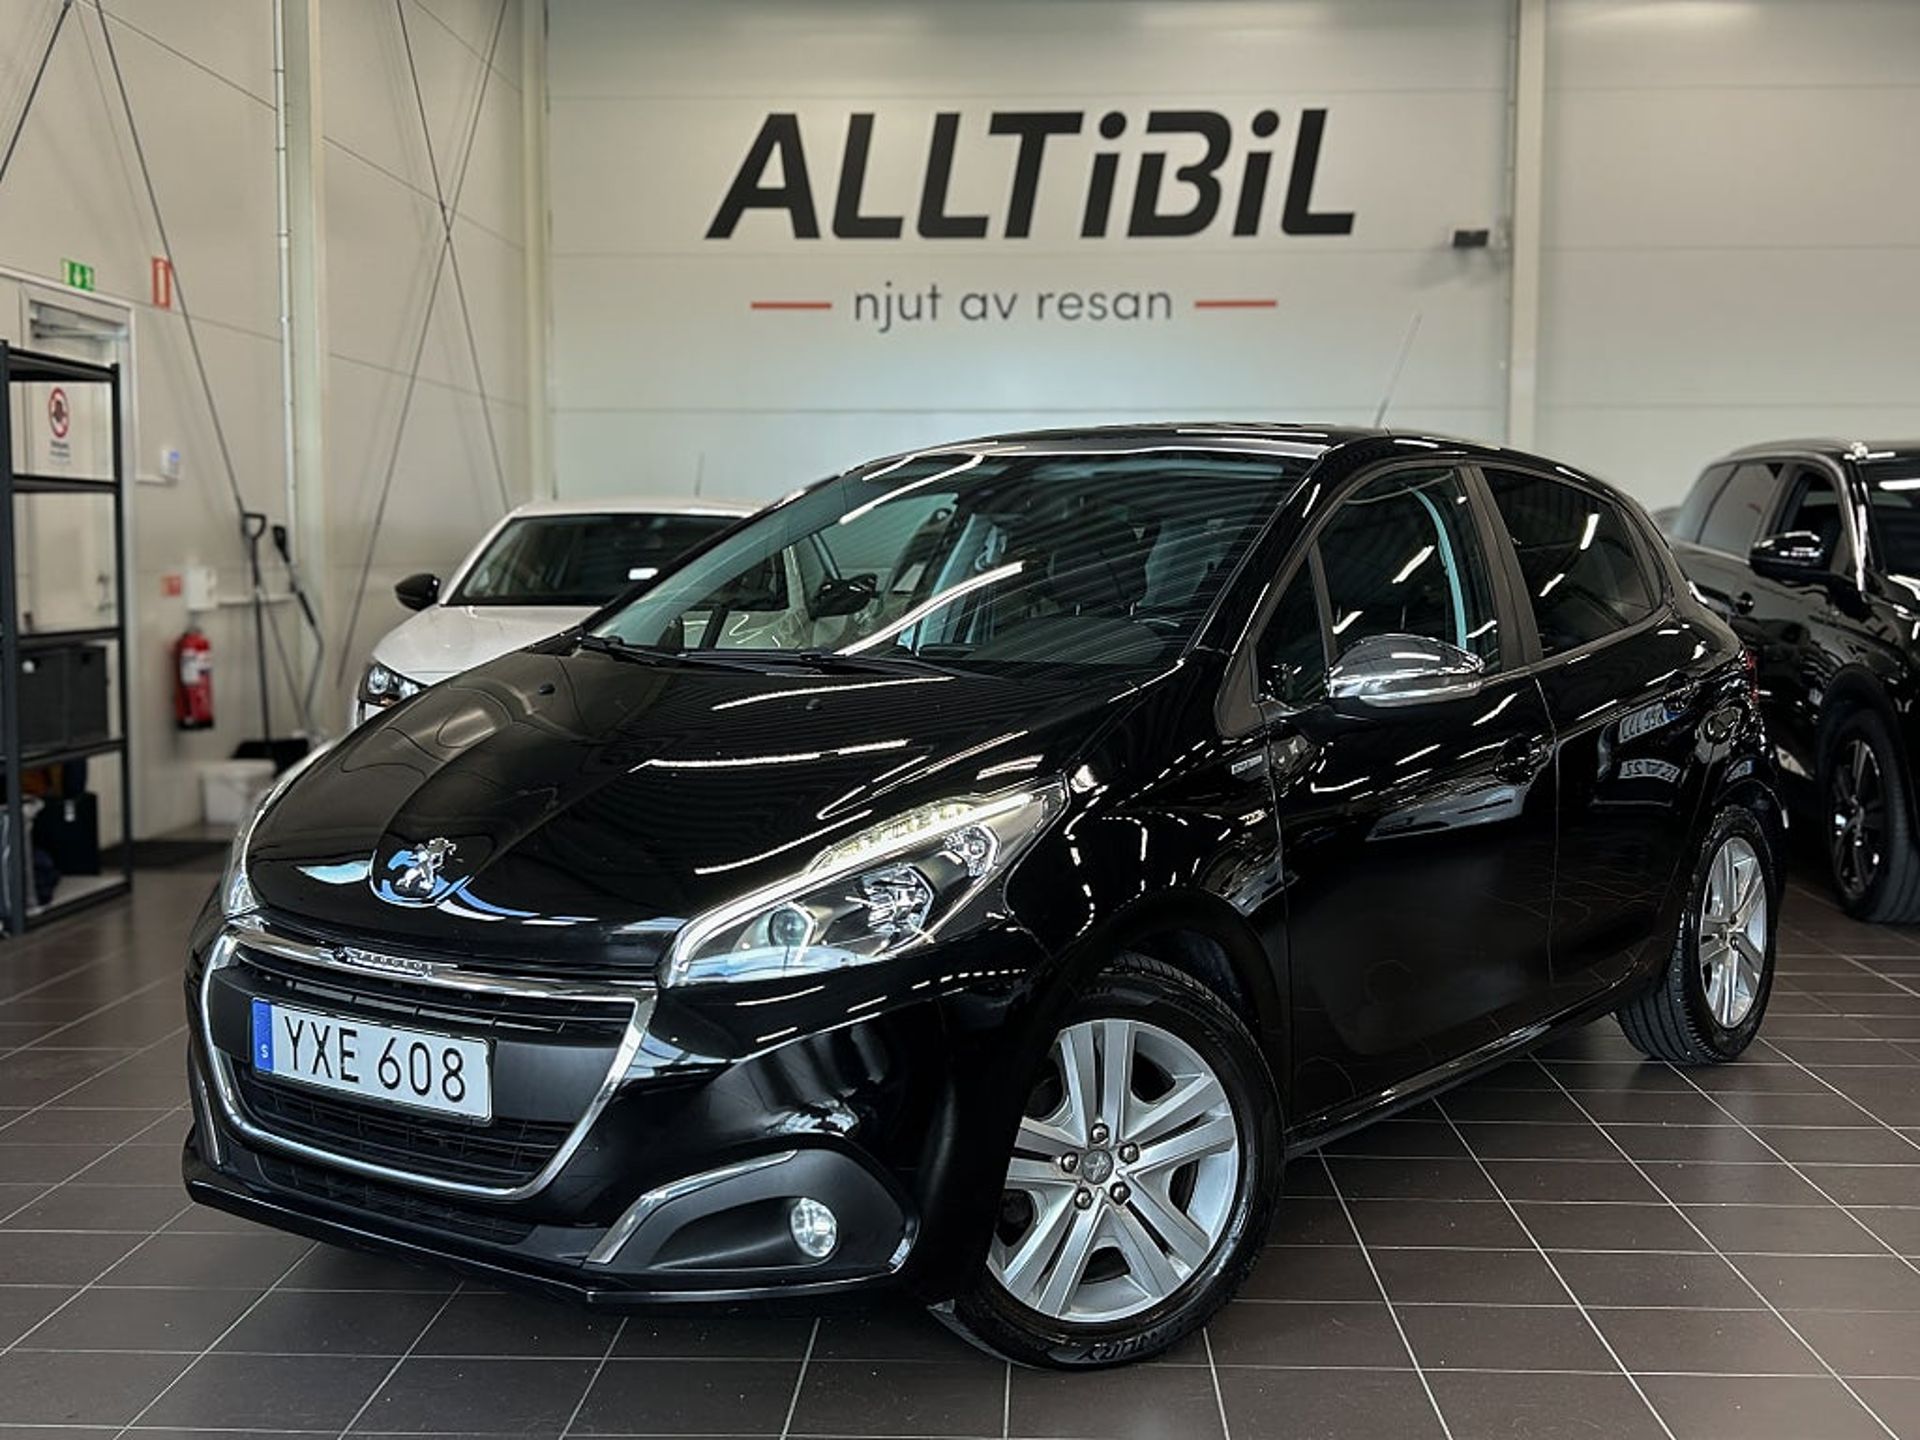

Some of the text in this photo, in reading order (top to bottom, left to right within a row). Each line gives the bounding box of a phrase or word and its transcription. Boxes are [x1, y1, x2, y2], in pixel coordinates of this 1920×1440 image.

[853, 281, 1173, 333] njut av resan
[260, 1044, 269, 1059] S
[284, 1015, 466, 1103] YXE 608
